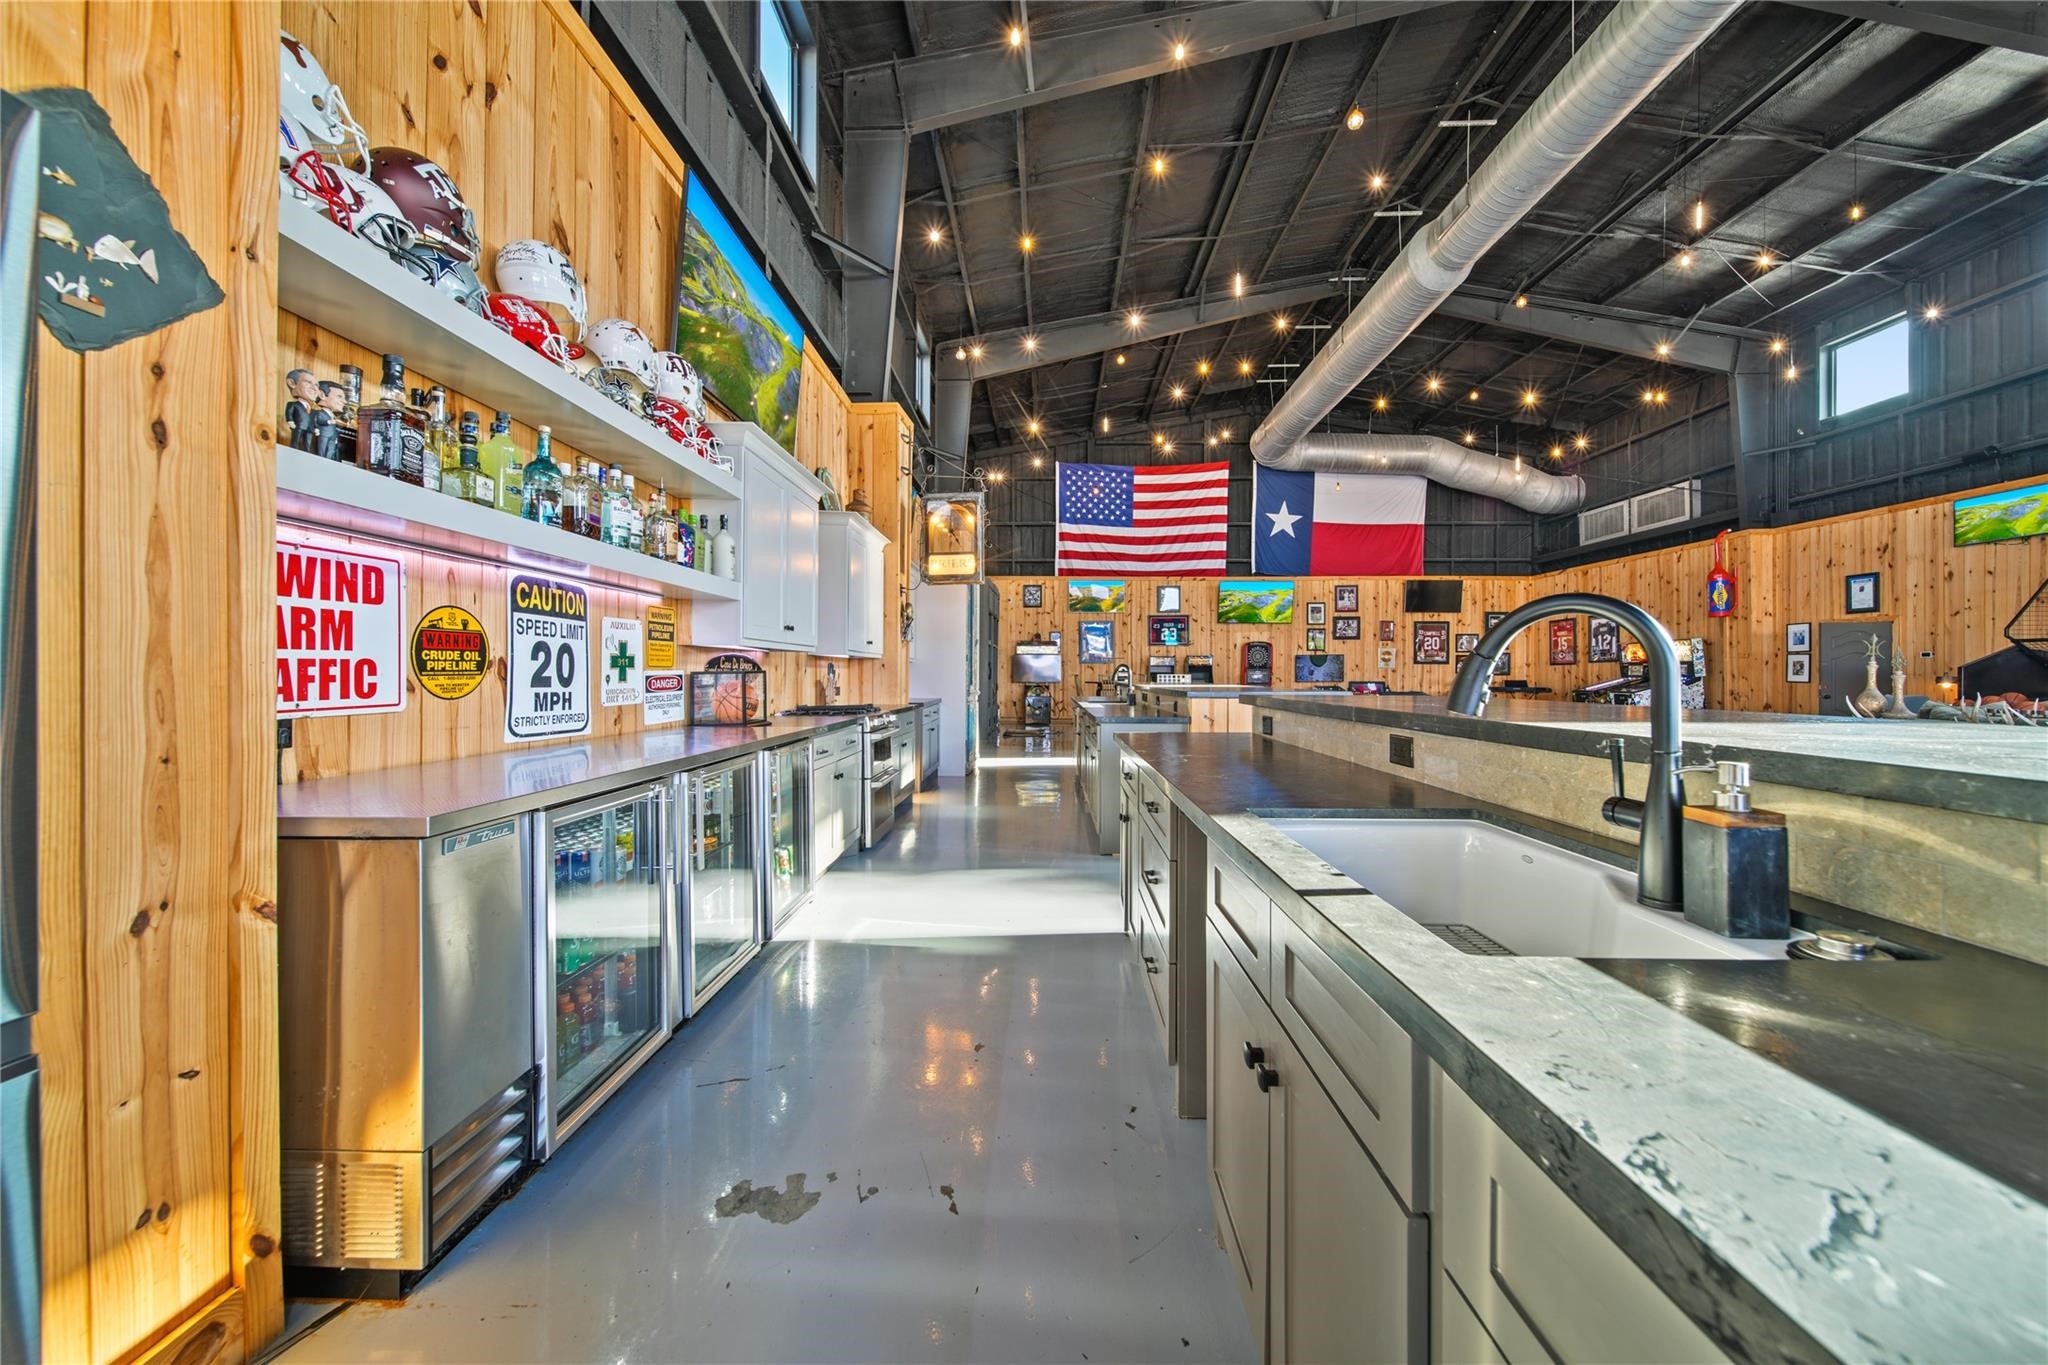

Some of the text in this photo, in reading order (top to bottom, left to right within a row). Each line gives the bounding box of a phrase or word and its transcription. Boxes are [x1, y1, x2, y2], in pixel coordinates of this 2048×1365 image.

[613, 506, 631, 514] BACARD
[277, 552, 384, 605] WIND
[516, 582, 585, 616] CAUTION
[651, 611, 672, 621] WARNING
[516, 617, 585, 640] SPEED LIMIT
[610, 621, 636, 631] AUXILIO
[648, 623, 674, 632] PETROLEUM
[424, 633, 479, 649] WARNING
[651, 631, 671, 639] PIPELINE
[1161, 627, 1177, 641] 23
[1424, 636, 1440, 650] 20
[1557, 636, 1568, 650] 15
[1597, 633, 1611, 650] 12
[421, 650, 482, 661] CRUDE OIL
[427, 661, 477, 671] PIPELINE
[530, 640, 575, 688] 20
[651, 679, 678, 689] DANGER
[534, 692, 572, 712] MPH
[514, 712, 586, 728] STRICTLY ENFORCED
[477, 827, 510, 842] True
